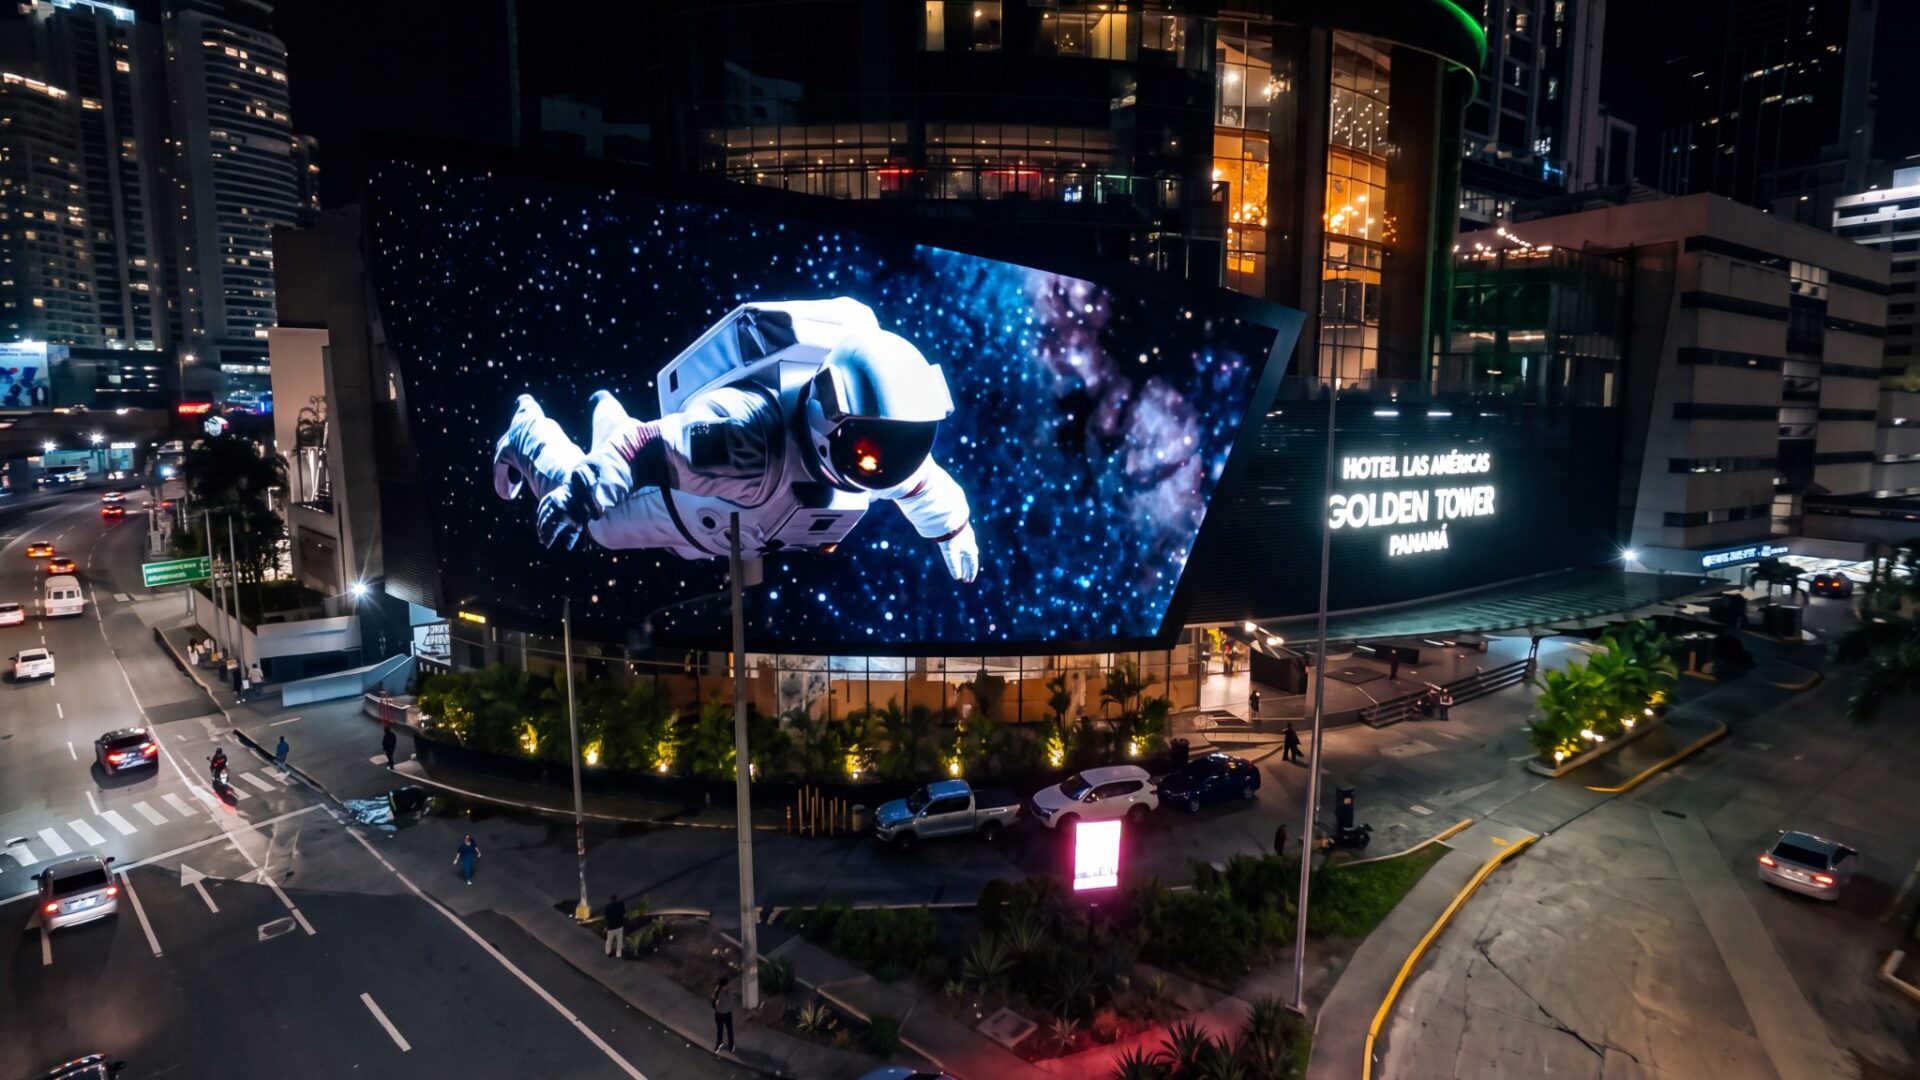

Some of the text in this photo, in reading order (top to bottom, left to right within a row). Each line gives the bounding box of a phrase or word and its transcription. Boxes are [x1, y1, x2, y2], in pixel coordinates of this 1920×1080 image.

[1342, 449, 1491, 479] HOTEL LAS AMÉRICAS
[1328, 486, 1495, 529] GOLDEN TOWER
[1389, 523, 1449, 556] PANAMÁ
